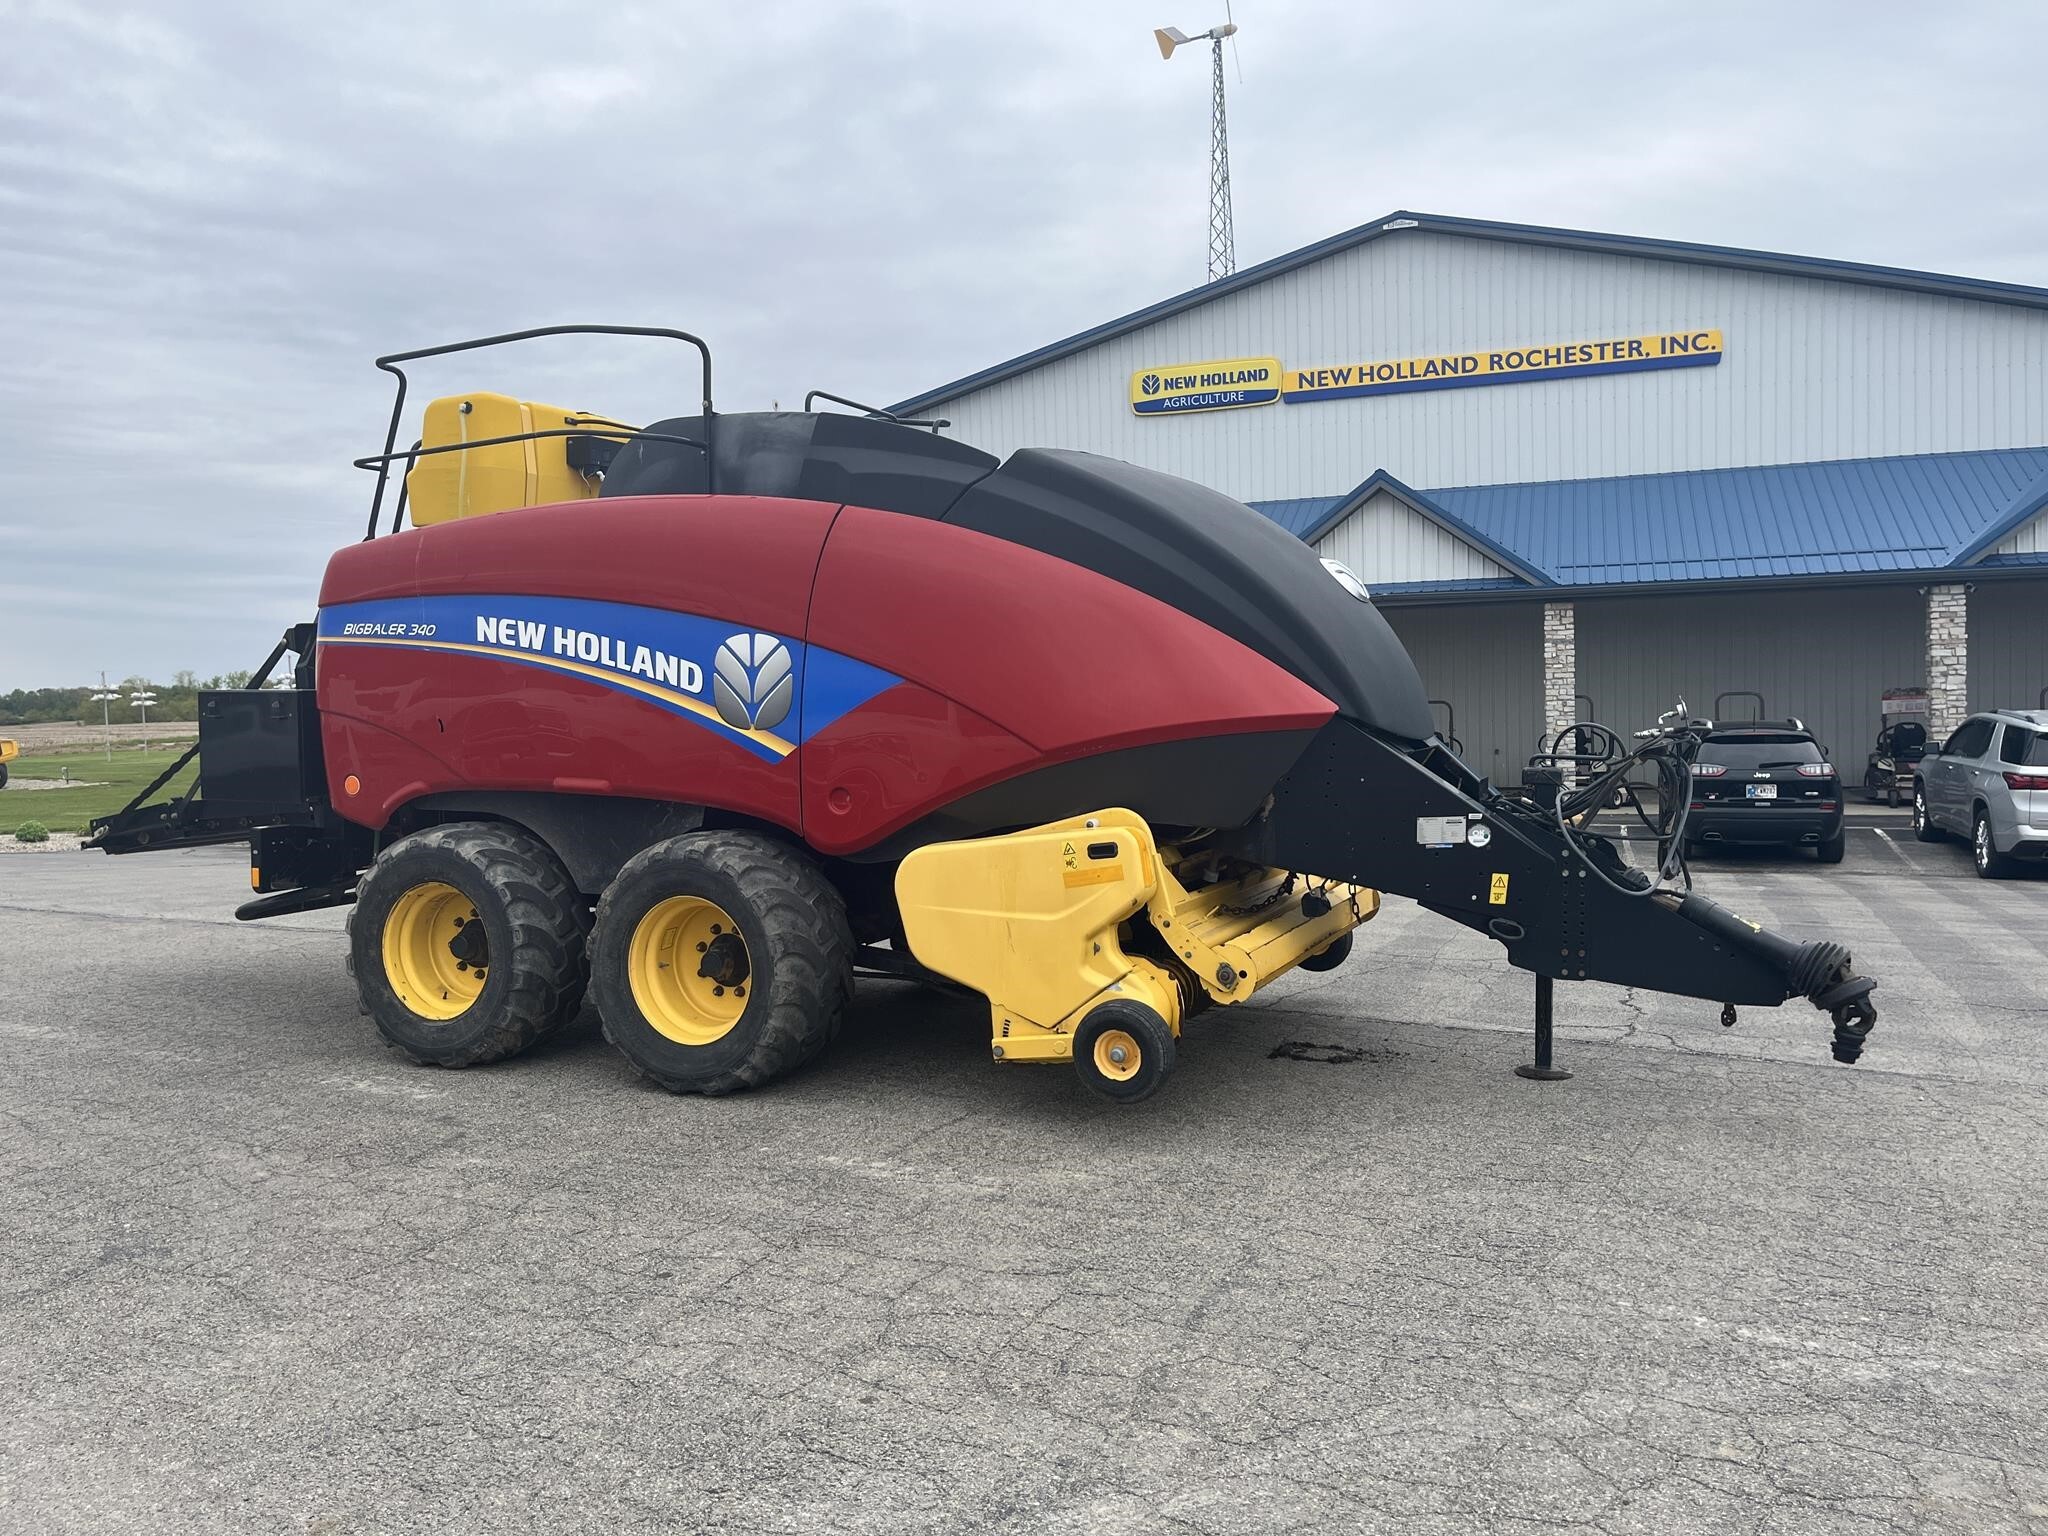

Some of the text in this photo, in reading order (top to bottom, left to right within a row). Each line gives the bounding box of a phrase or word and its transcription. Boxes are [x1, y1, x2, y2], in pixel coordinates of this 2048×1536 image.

[1298, 333, 1717, 389] NEW HOLLAND ROCHESTER, INC.
[1164, 368, 1269, 391] NEW HOLLAND
[1162, 391, 1245, 409] AGRICULTURE
[343, 623, 437, 636] BIGBALER 340
[476, 615, 704, 694] NEW HOLLAND
